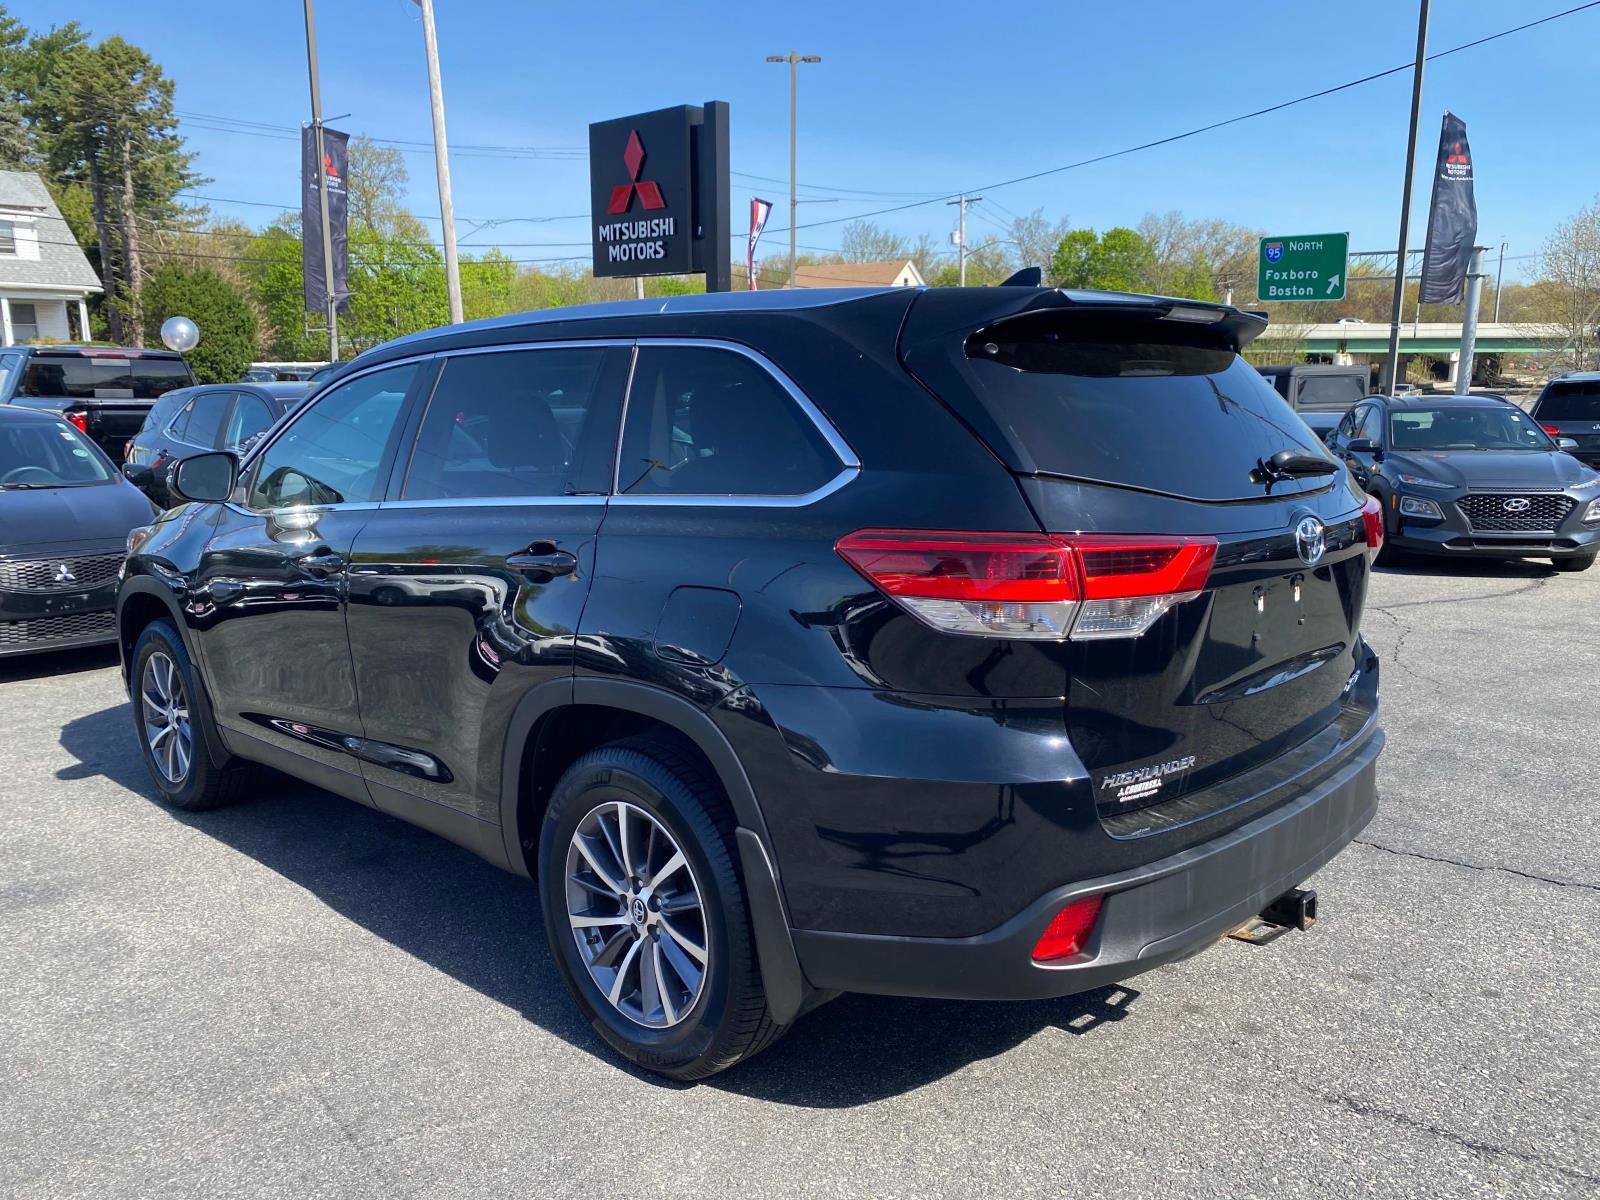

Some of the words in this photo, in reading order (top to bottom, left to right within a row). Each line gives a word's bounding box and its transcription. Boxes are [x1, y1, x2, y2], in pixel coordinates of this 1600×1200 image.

[598, 217, 674, 242] MITSUBISHI
[608, 240, 665, 262] MOTORS
[1268, 248, 1281, 259] 95
[1265, 268, 1319, 281] Foxboro
[1268, 284, 1314, 297] Boston
[1100, 755, 1196, 790] HIGHLANDER
